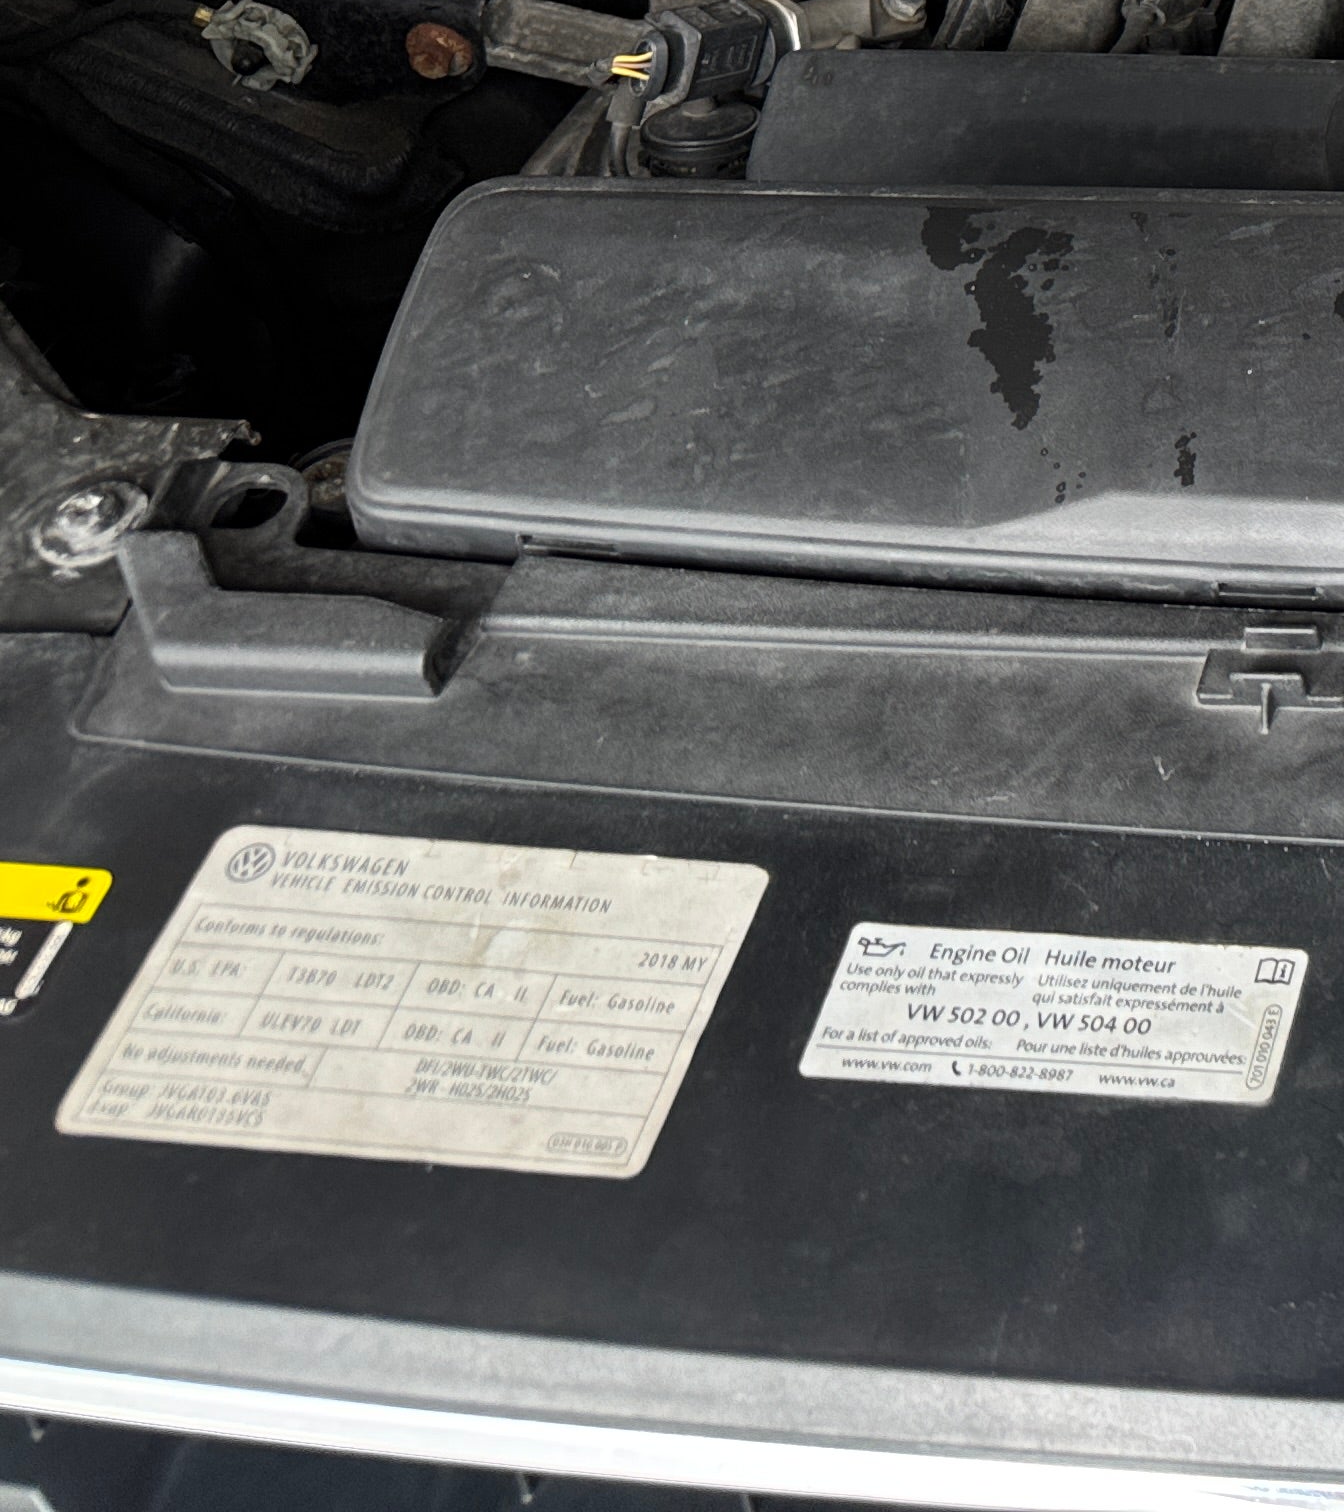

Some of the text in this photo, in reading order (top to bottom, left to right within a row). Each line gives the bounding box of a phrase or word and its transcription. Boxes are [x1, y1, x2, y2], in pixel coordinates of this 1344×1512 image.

[281, 851, 410, 877] VOLKSWAGEN
[270, 872, 612, 914] VEHICLE EMISSION CONTROL INFORMATION
[194, 916, 384, 946] Conforms to regulations:
[637, 951, 708, 972] 2018 MY
[929, 943, 1031, 965] Engine Oil
[1044, 949, 1176, 974] Huile moteur
[846, 962, 1024, 989] Use only oil that expressly
[1037, 974, 1243, 999] Utilisez uniquement de l'huile
[426, 978, 495, 998] OBD: CA
[839, 980, 936, 996] complies with
[559, 990, 675, 1015] Fuel: Gasoline
[1031, 991, 1225, 1014] qui satisfait expressément à
[908, 1003, 1152, 1035] VW 502 00 VW 504 00
[403, 1024, 473, 1045] OBD: CA
[821, 1026, 992, 1050] For a list of approved oils:
[536, 1035, 655, 1061] Fuel: Gasoline
[1016, 1038, 1247, 1065] Pour une liste d'huiles approuvées:
[841, 1058, 933, 1073] www.vw.com
[968, 1063, 1074, 1082] 1-800-822-8987
[1098, 1074, 1176, 1089] www.vw.ca
